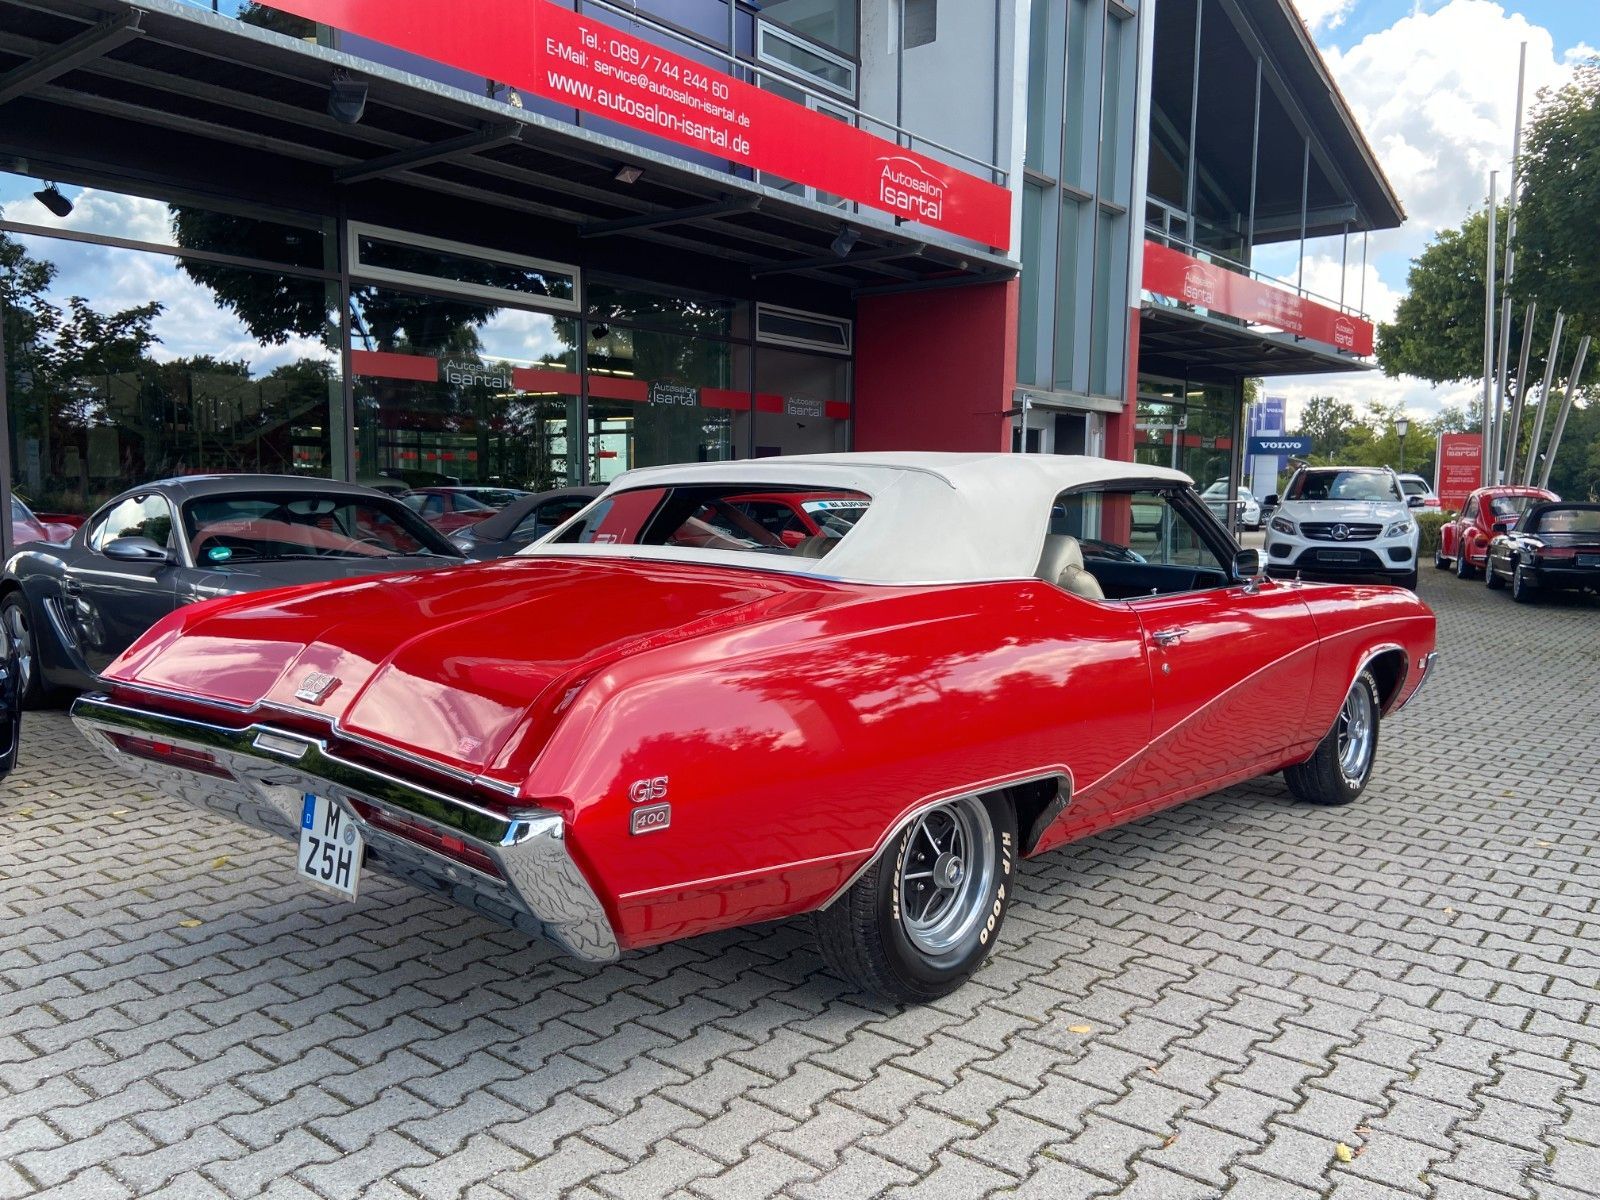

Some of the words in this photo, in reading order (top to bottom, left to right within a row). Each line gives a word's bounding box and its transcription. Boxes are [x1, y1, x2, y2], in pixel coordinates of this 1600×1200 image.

[578, 27, 607, 53] Tel.:
[610, 40, 639, 65] 089
[641, 55, 650, 69] /
[653, 57, 679, 81] 744
[683, 71, 708, 92] 244
[711, 81, 729, 100] 60
[546, 38, 589, 68] E-Mail:
[594, 59, 750, 128] service@autosalon-isartal.de
[547, 71, 750, 155] www.autosalon-isartal.de
[881, 164, 943, 199] Autosalon
[880, 178, 943, 221] Isartal
[446, 368, 506, 388] Isartal
[653, 390, 697, 406] Isartal
[787, 403, 822, 416] Isartal
[1259, 441, 1302, 449] VOLVO
[629, 775, 669, 802] GS
[306, 813, 311, 824] D
[324, 800, 341, 839] M
[636, 811, 666, 828] 400
[305, 836, 353, 888] Z5H
[979, 883, 1006, 945] 4000
